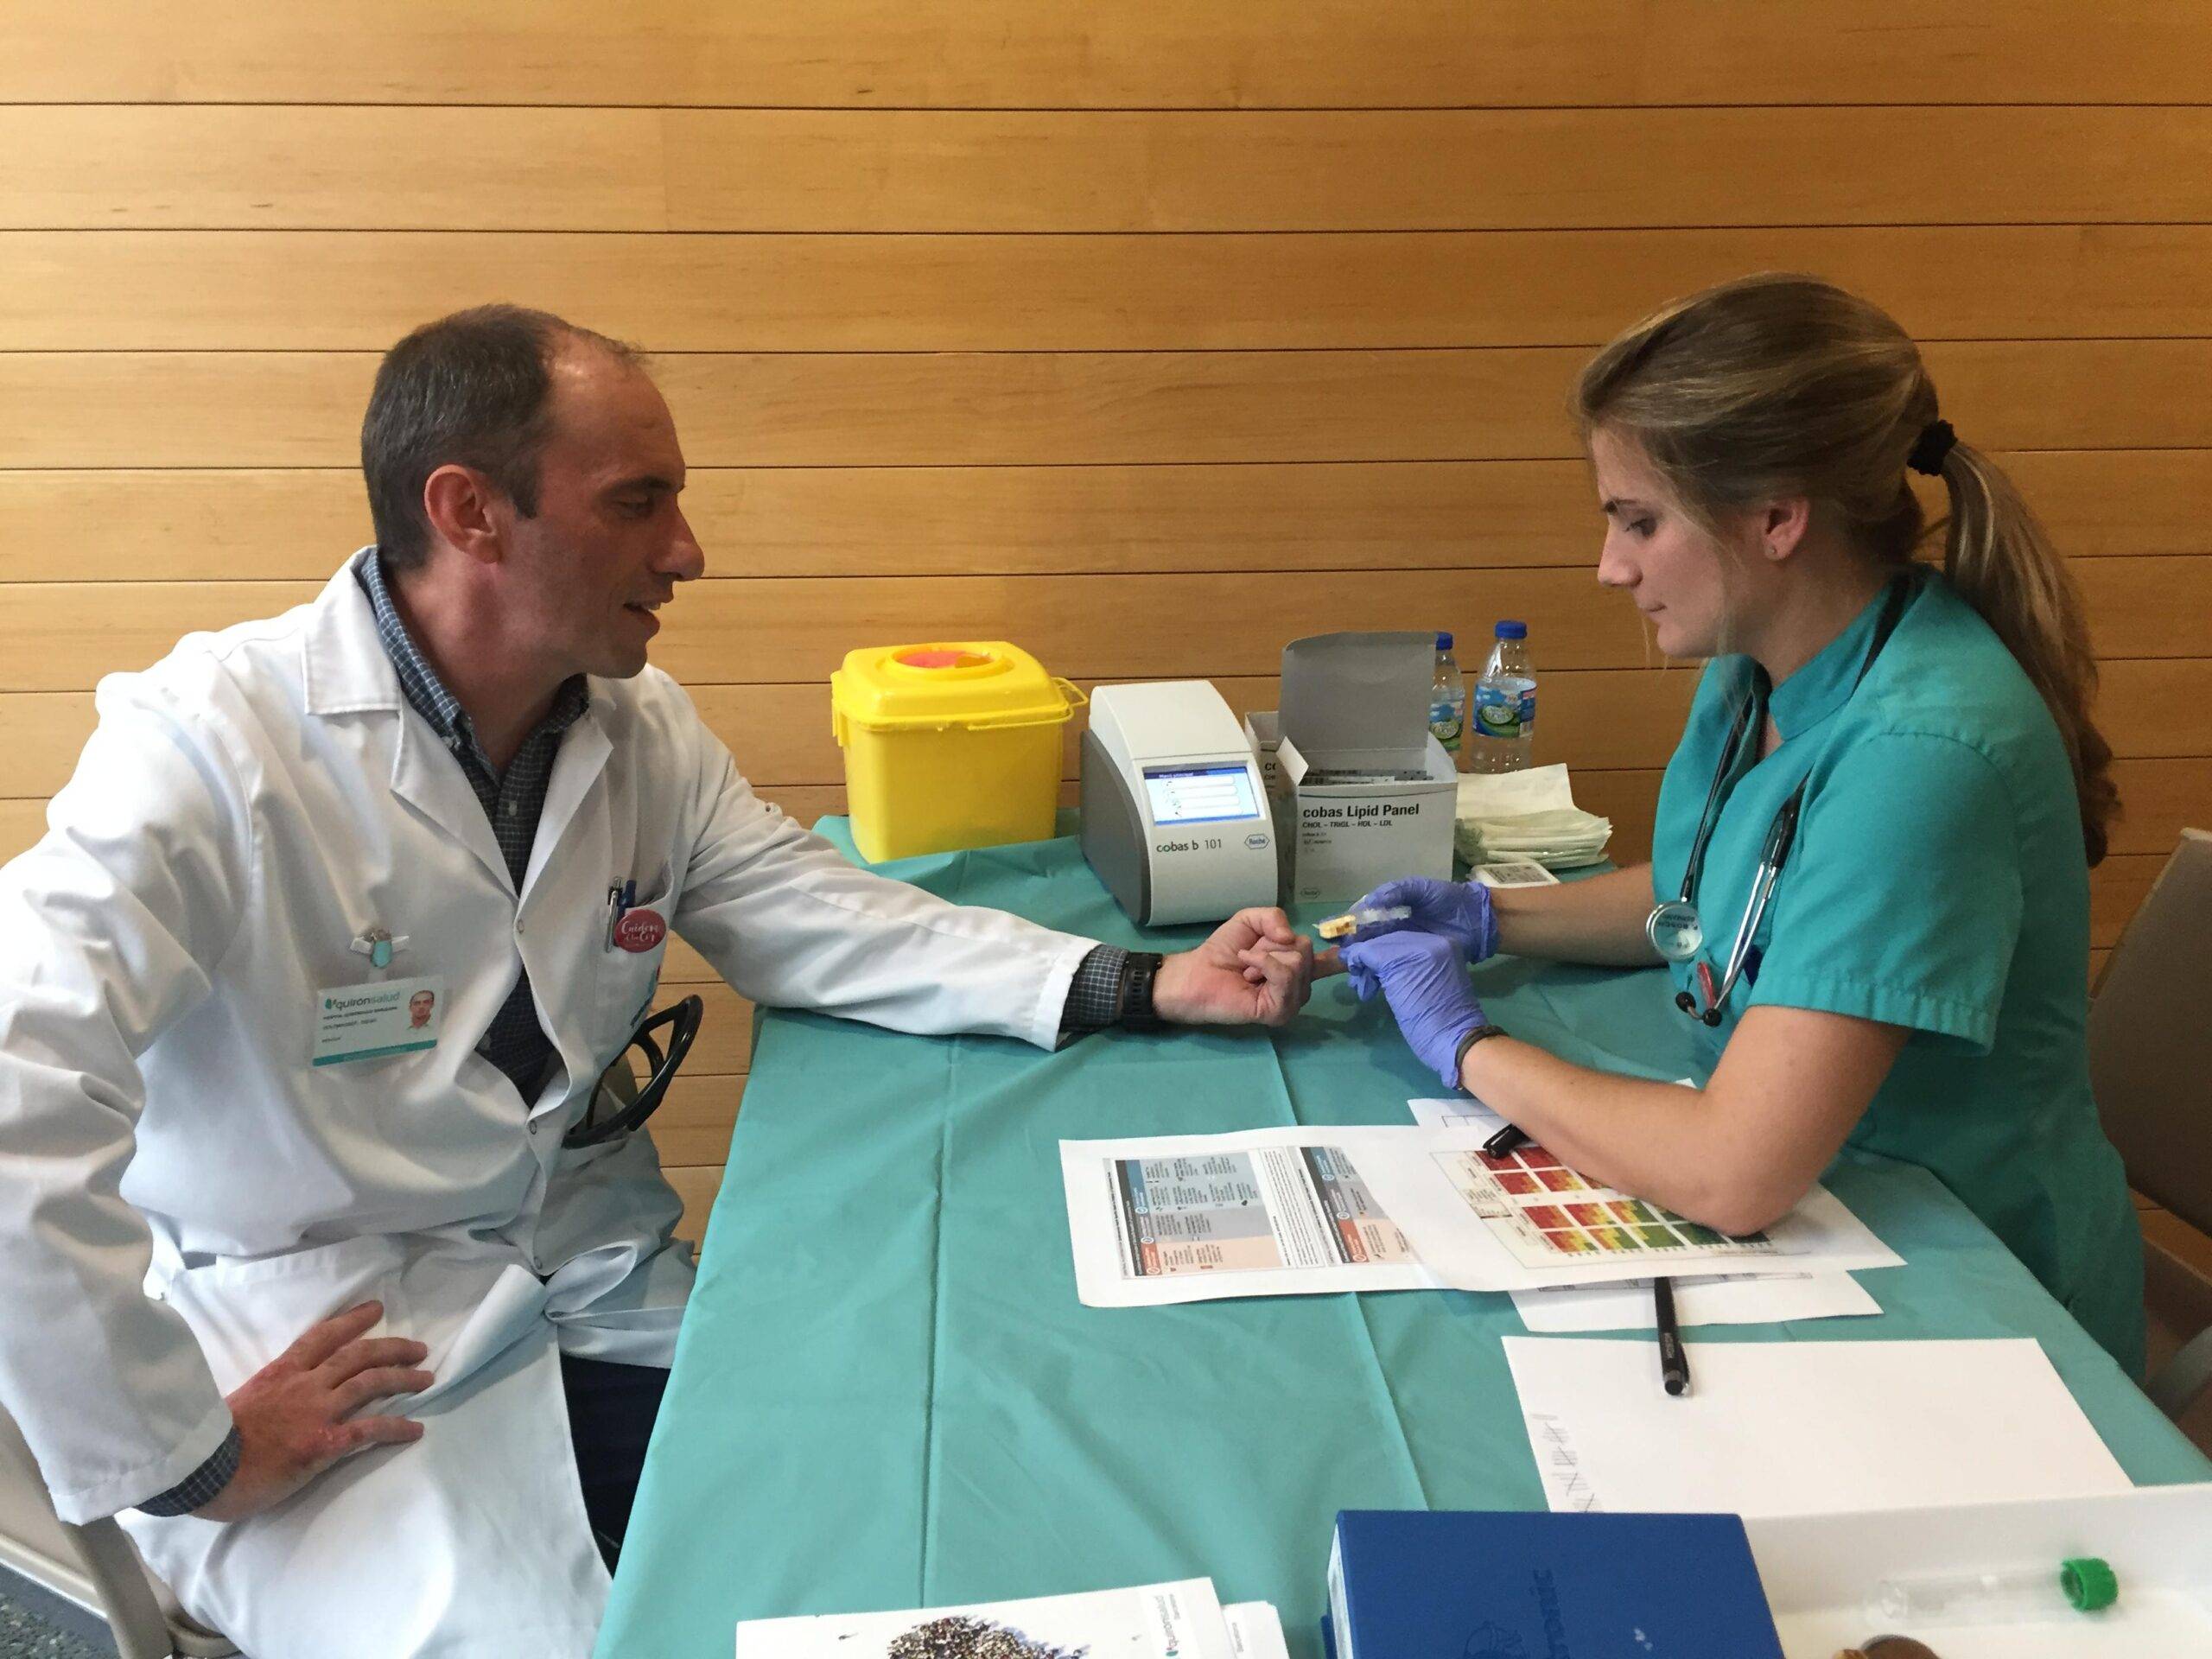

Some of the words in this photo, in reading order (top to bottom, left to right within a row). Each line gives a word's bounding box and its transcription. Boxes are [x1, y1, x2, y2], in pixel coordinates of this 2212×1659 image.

[1303, 806, 1343, 818] cobas
[1347, 804, 1379, 820] Lipid
[1382, 803, 1420, 816] Panel
[1156, 841, 1189, 853] cobas
[1192, 840, 1199, 850] b
[1205, 838, 1222, 849] 101
